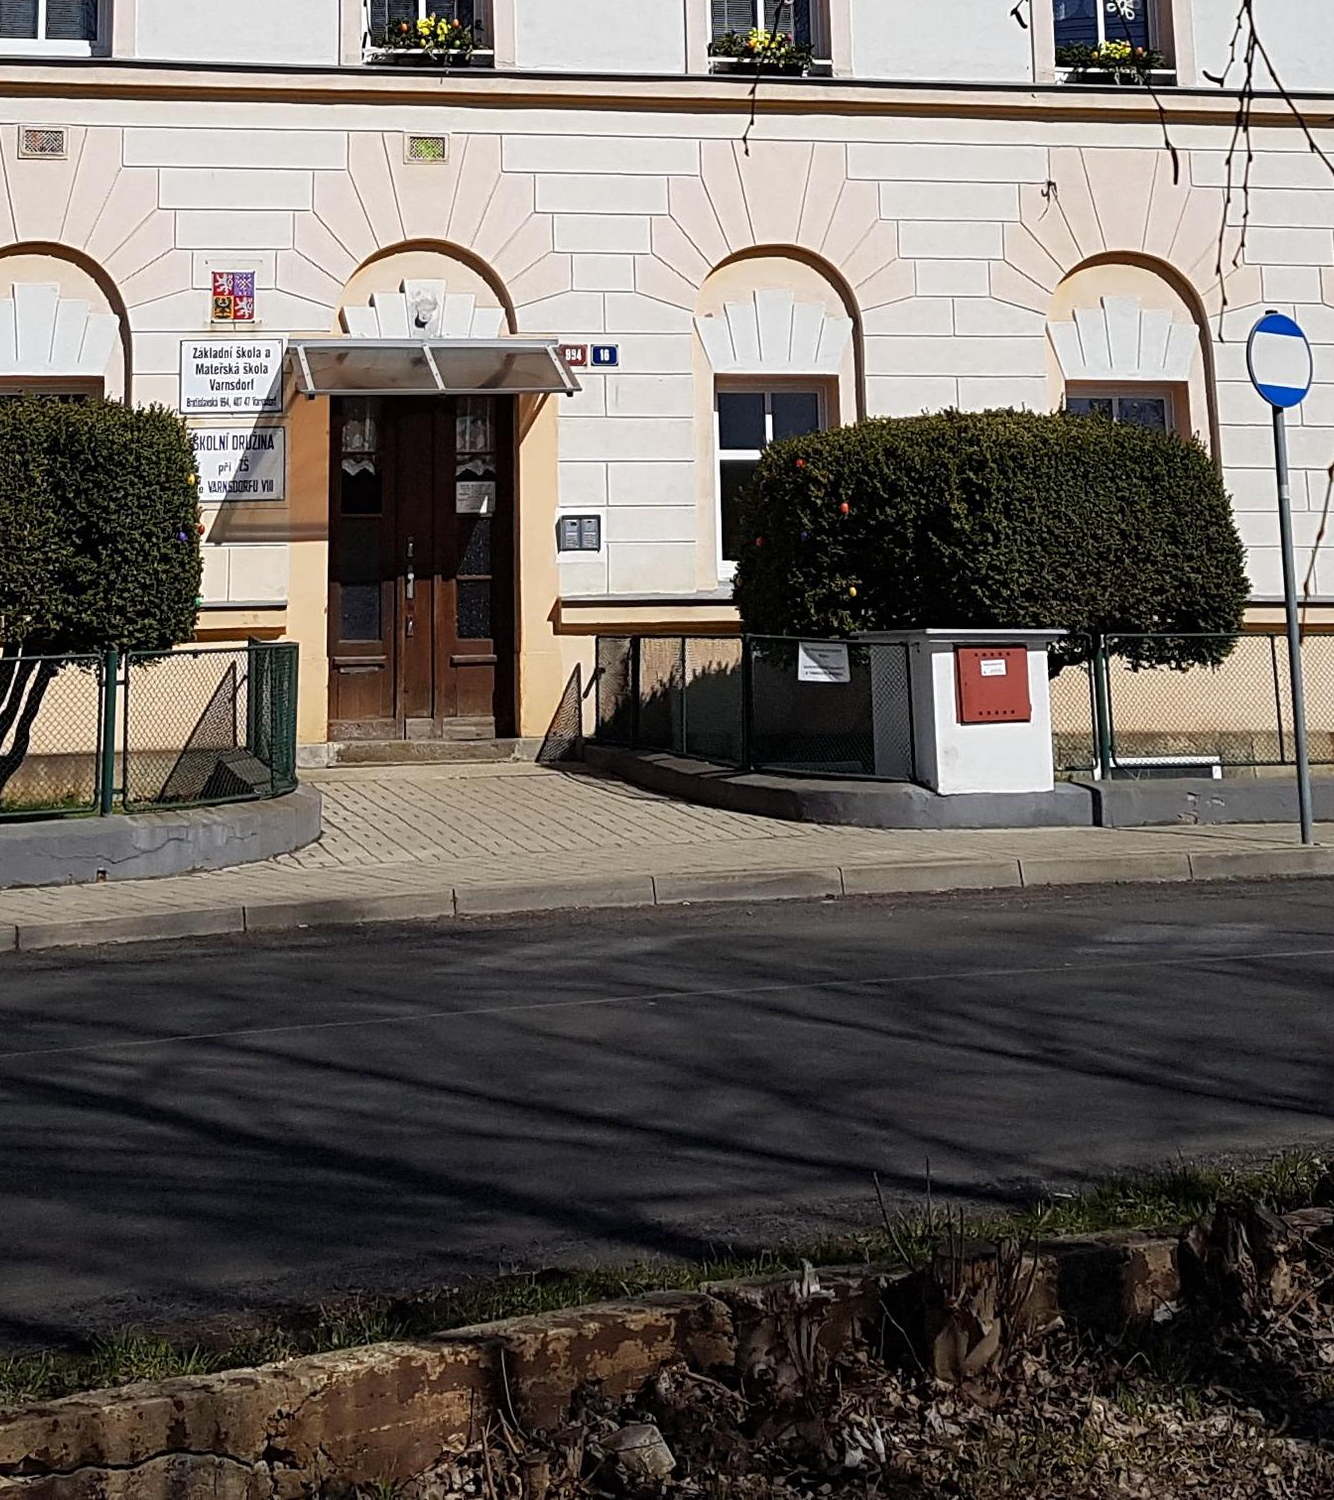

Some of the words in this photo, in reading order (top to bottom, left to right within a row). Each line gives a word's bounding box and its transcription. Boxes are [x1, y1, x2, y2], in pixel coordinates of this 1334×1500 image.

[192, 346, 233, 359] Základní
[236, 346, 261, 359] škola
[265, 348, 271, 358] a
[600, 348, 610, 361] 16
[195, 362, 240, 375] Mateřská
[243, 362, 269, 375] škola
[209, 378, 255, 391] Varnsdorf
[193, 432, 229, 451] ŠKOLNÍ
[232, 432, 274, 451] DRUŽINA
[208, 480, 258, 494] VARNSDORFU
